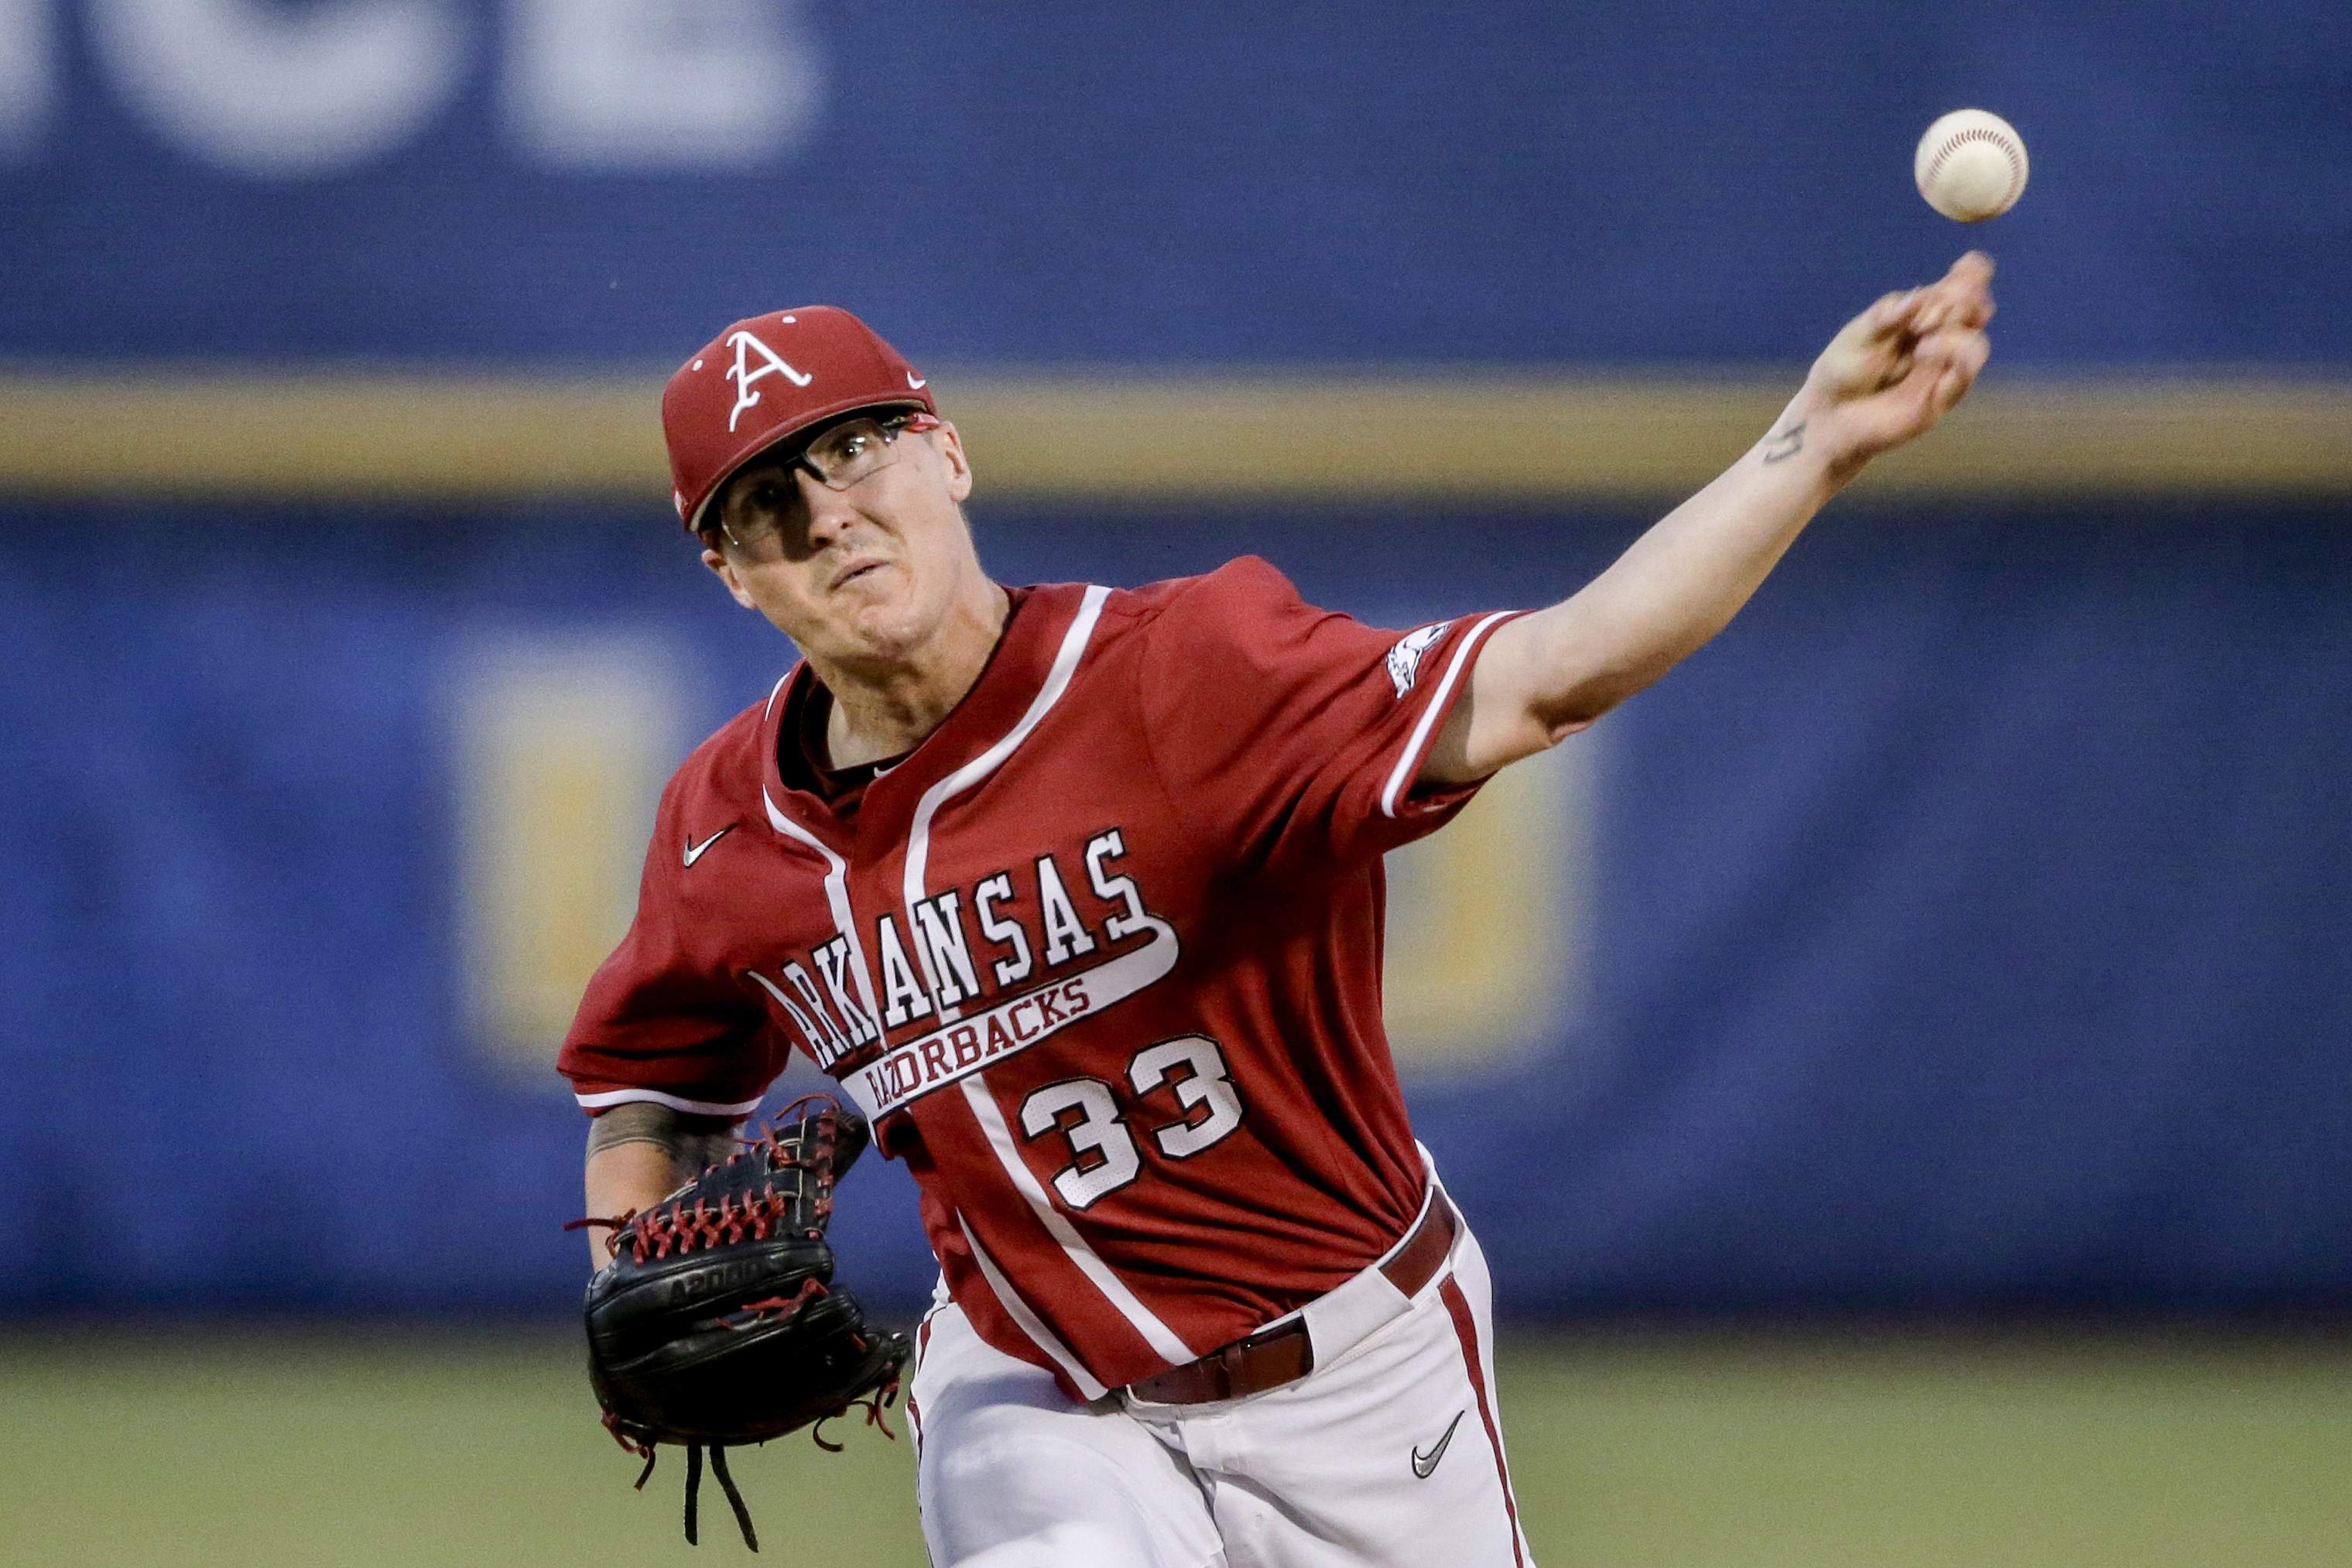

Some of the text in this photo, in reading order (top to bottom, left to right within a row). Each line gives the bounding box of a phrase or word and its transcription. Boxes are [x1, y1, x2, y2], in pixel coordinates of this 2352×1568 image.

[726, 330, 813, 433] A
[746, 826, 1151, 1073] ARKANSAS
[864, 978, 1091, 1110] RAZORBACKS
[1018, 1032, 1244, 1210] 33
